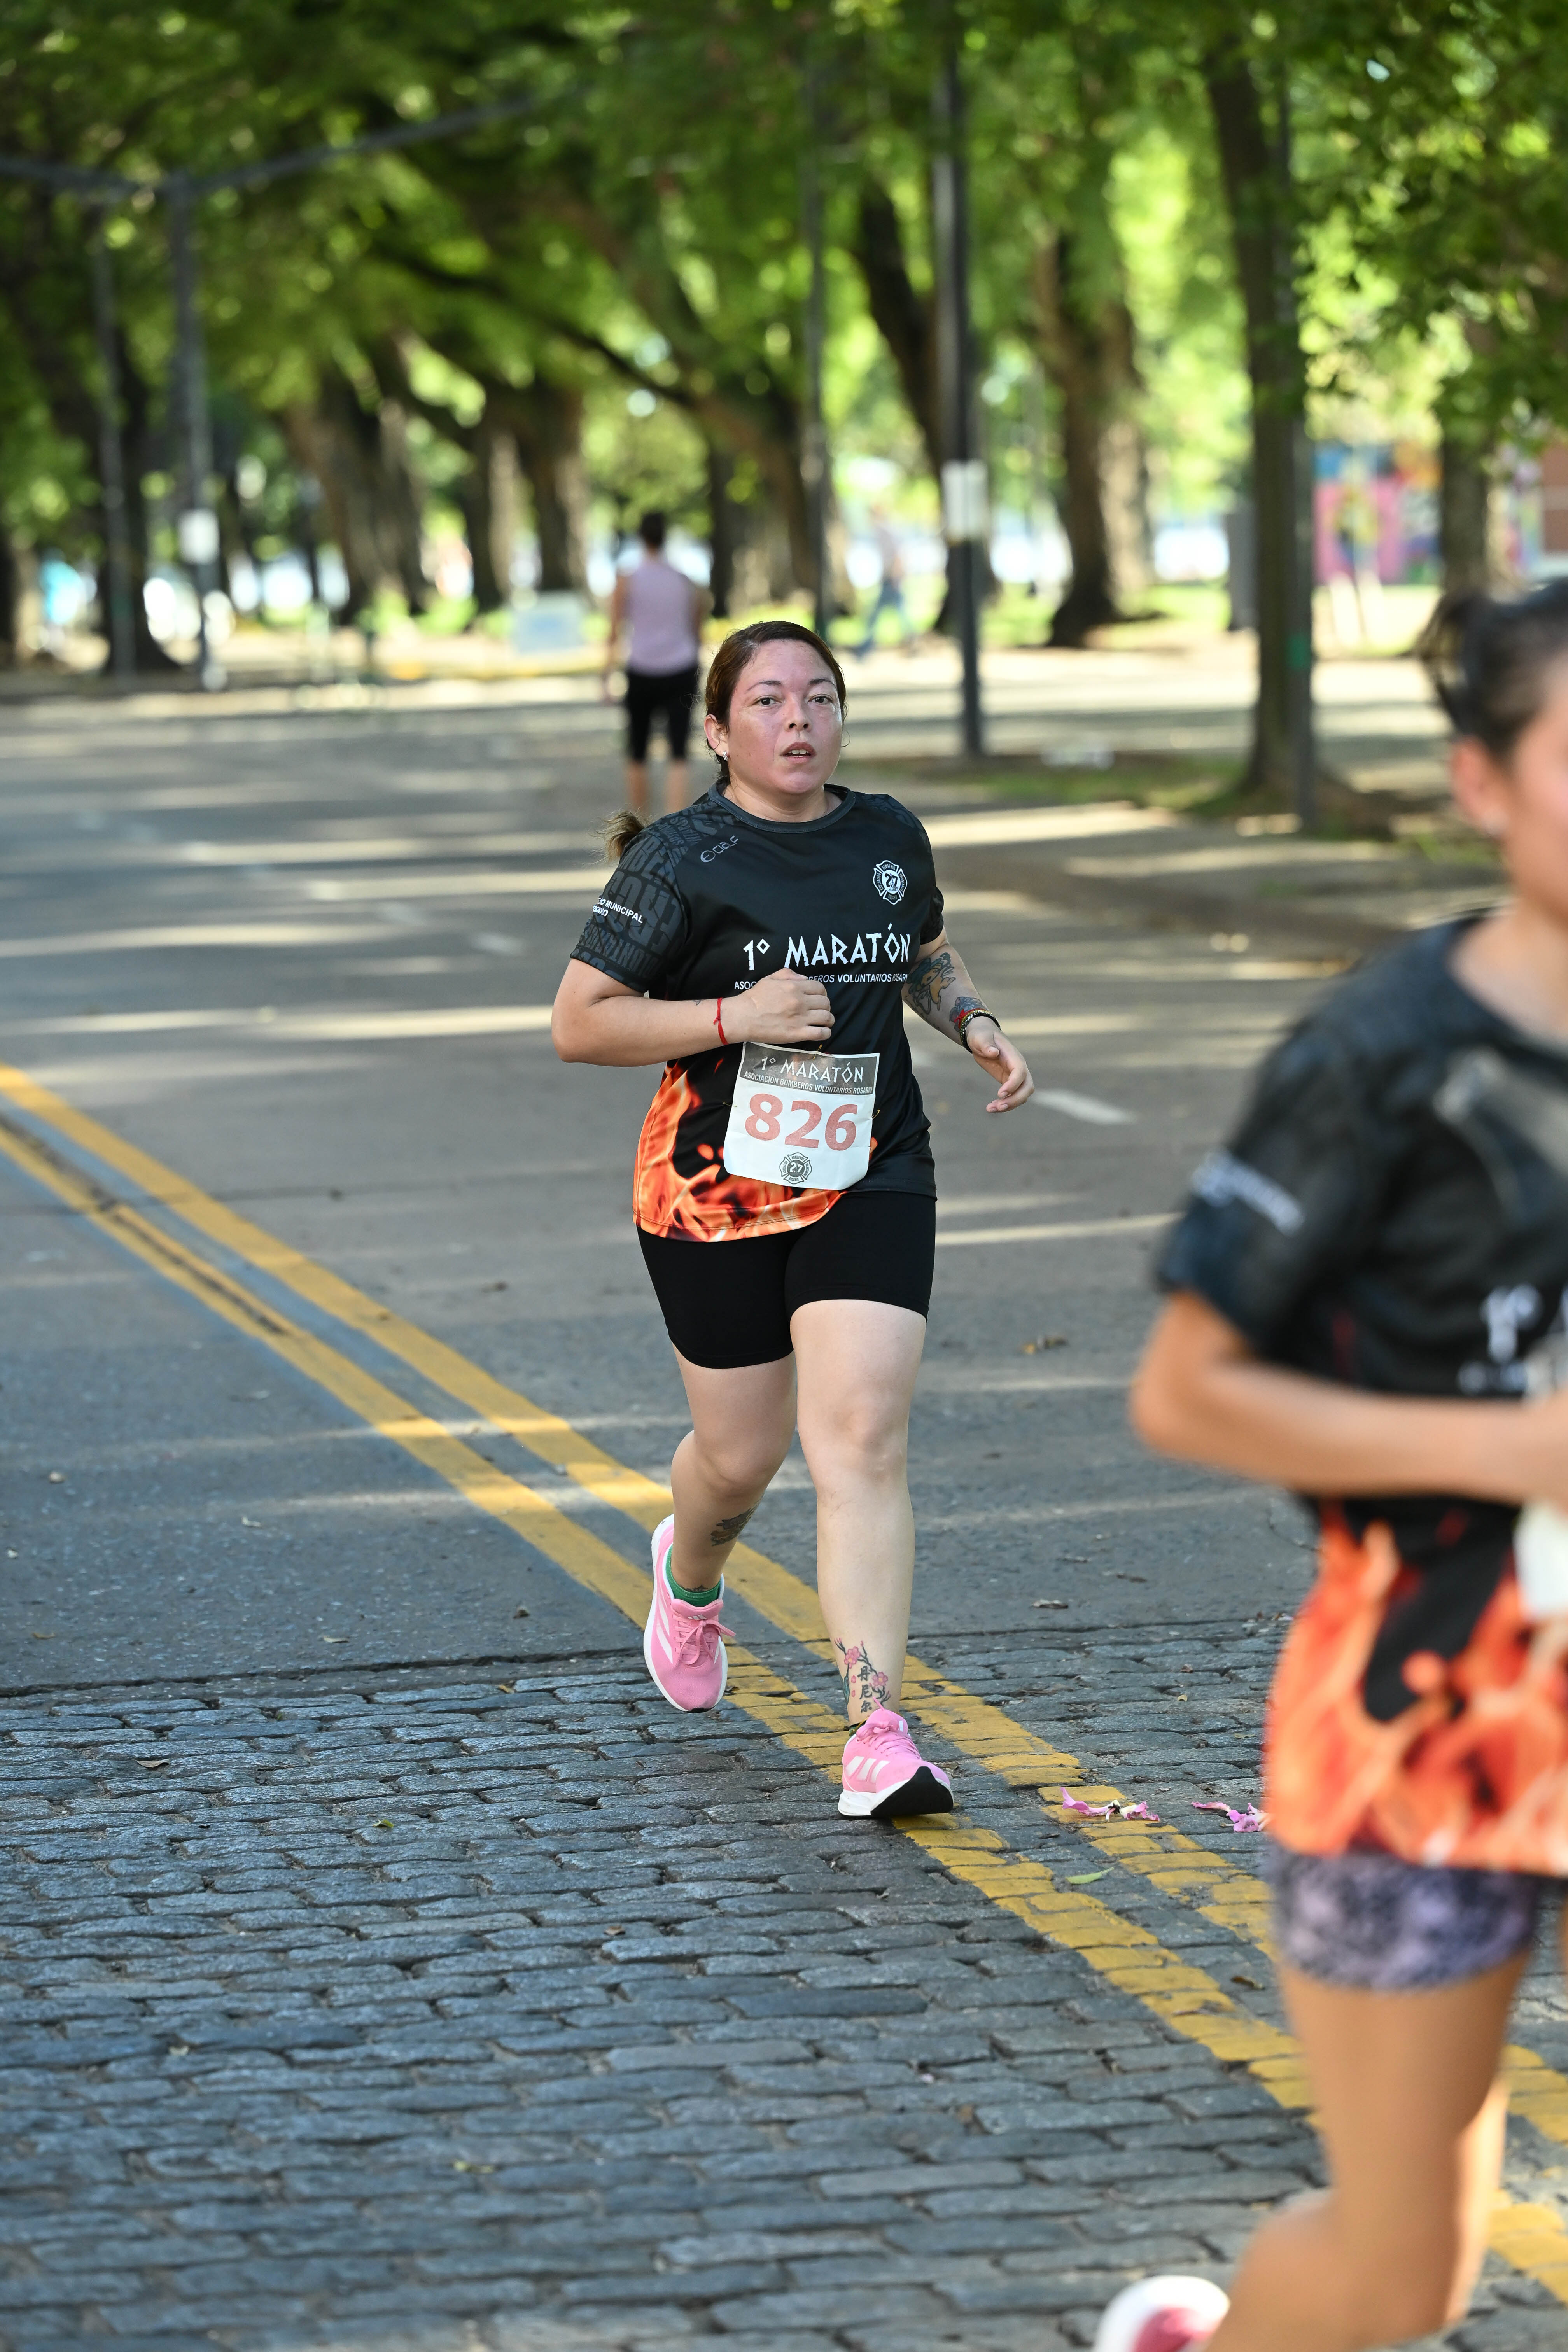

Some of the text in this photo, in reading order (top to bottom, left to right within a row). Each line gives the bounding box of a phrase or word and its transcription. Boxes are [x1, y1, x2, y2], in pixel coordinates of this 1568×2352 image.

[884, 873, 898, 887] 27
[605, 900, 643, 924] MUNICIPAL
[784, 922, 910, 968] MARATÓN
[837, 973, 892, 983] VOLUNTARIOS
[780, 1059, 864, 1083] MARATÓN
[780, 1079, 813, 1090] BOMBEROS
[814, 1084, 852, 1094] VOLUNTARIOS
[853, 1086, 872, 1094] ROSARIO
[745, 1093, 858, 1151] 826
[789, 1162, 803, 1173] 27
